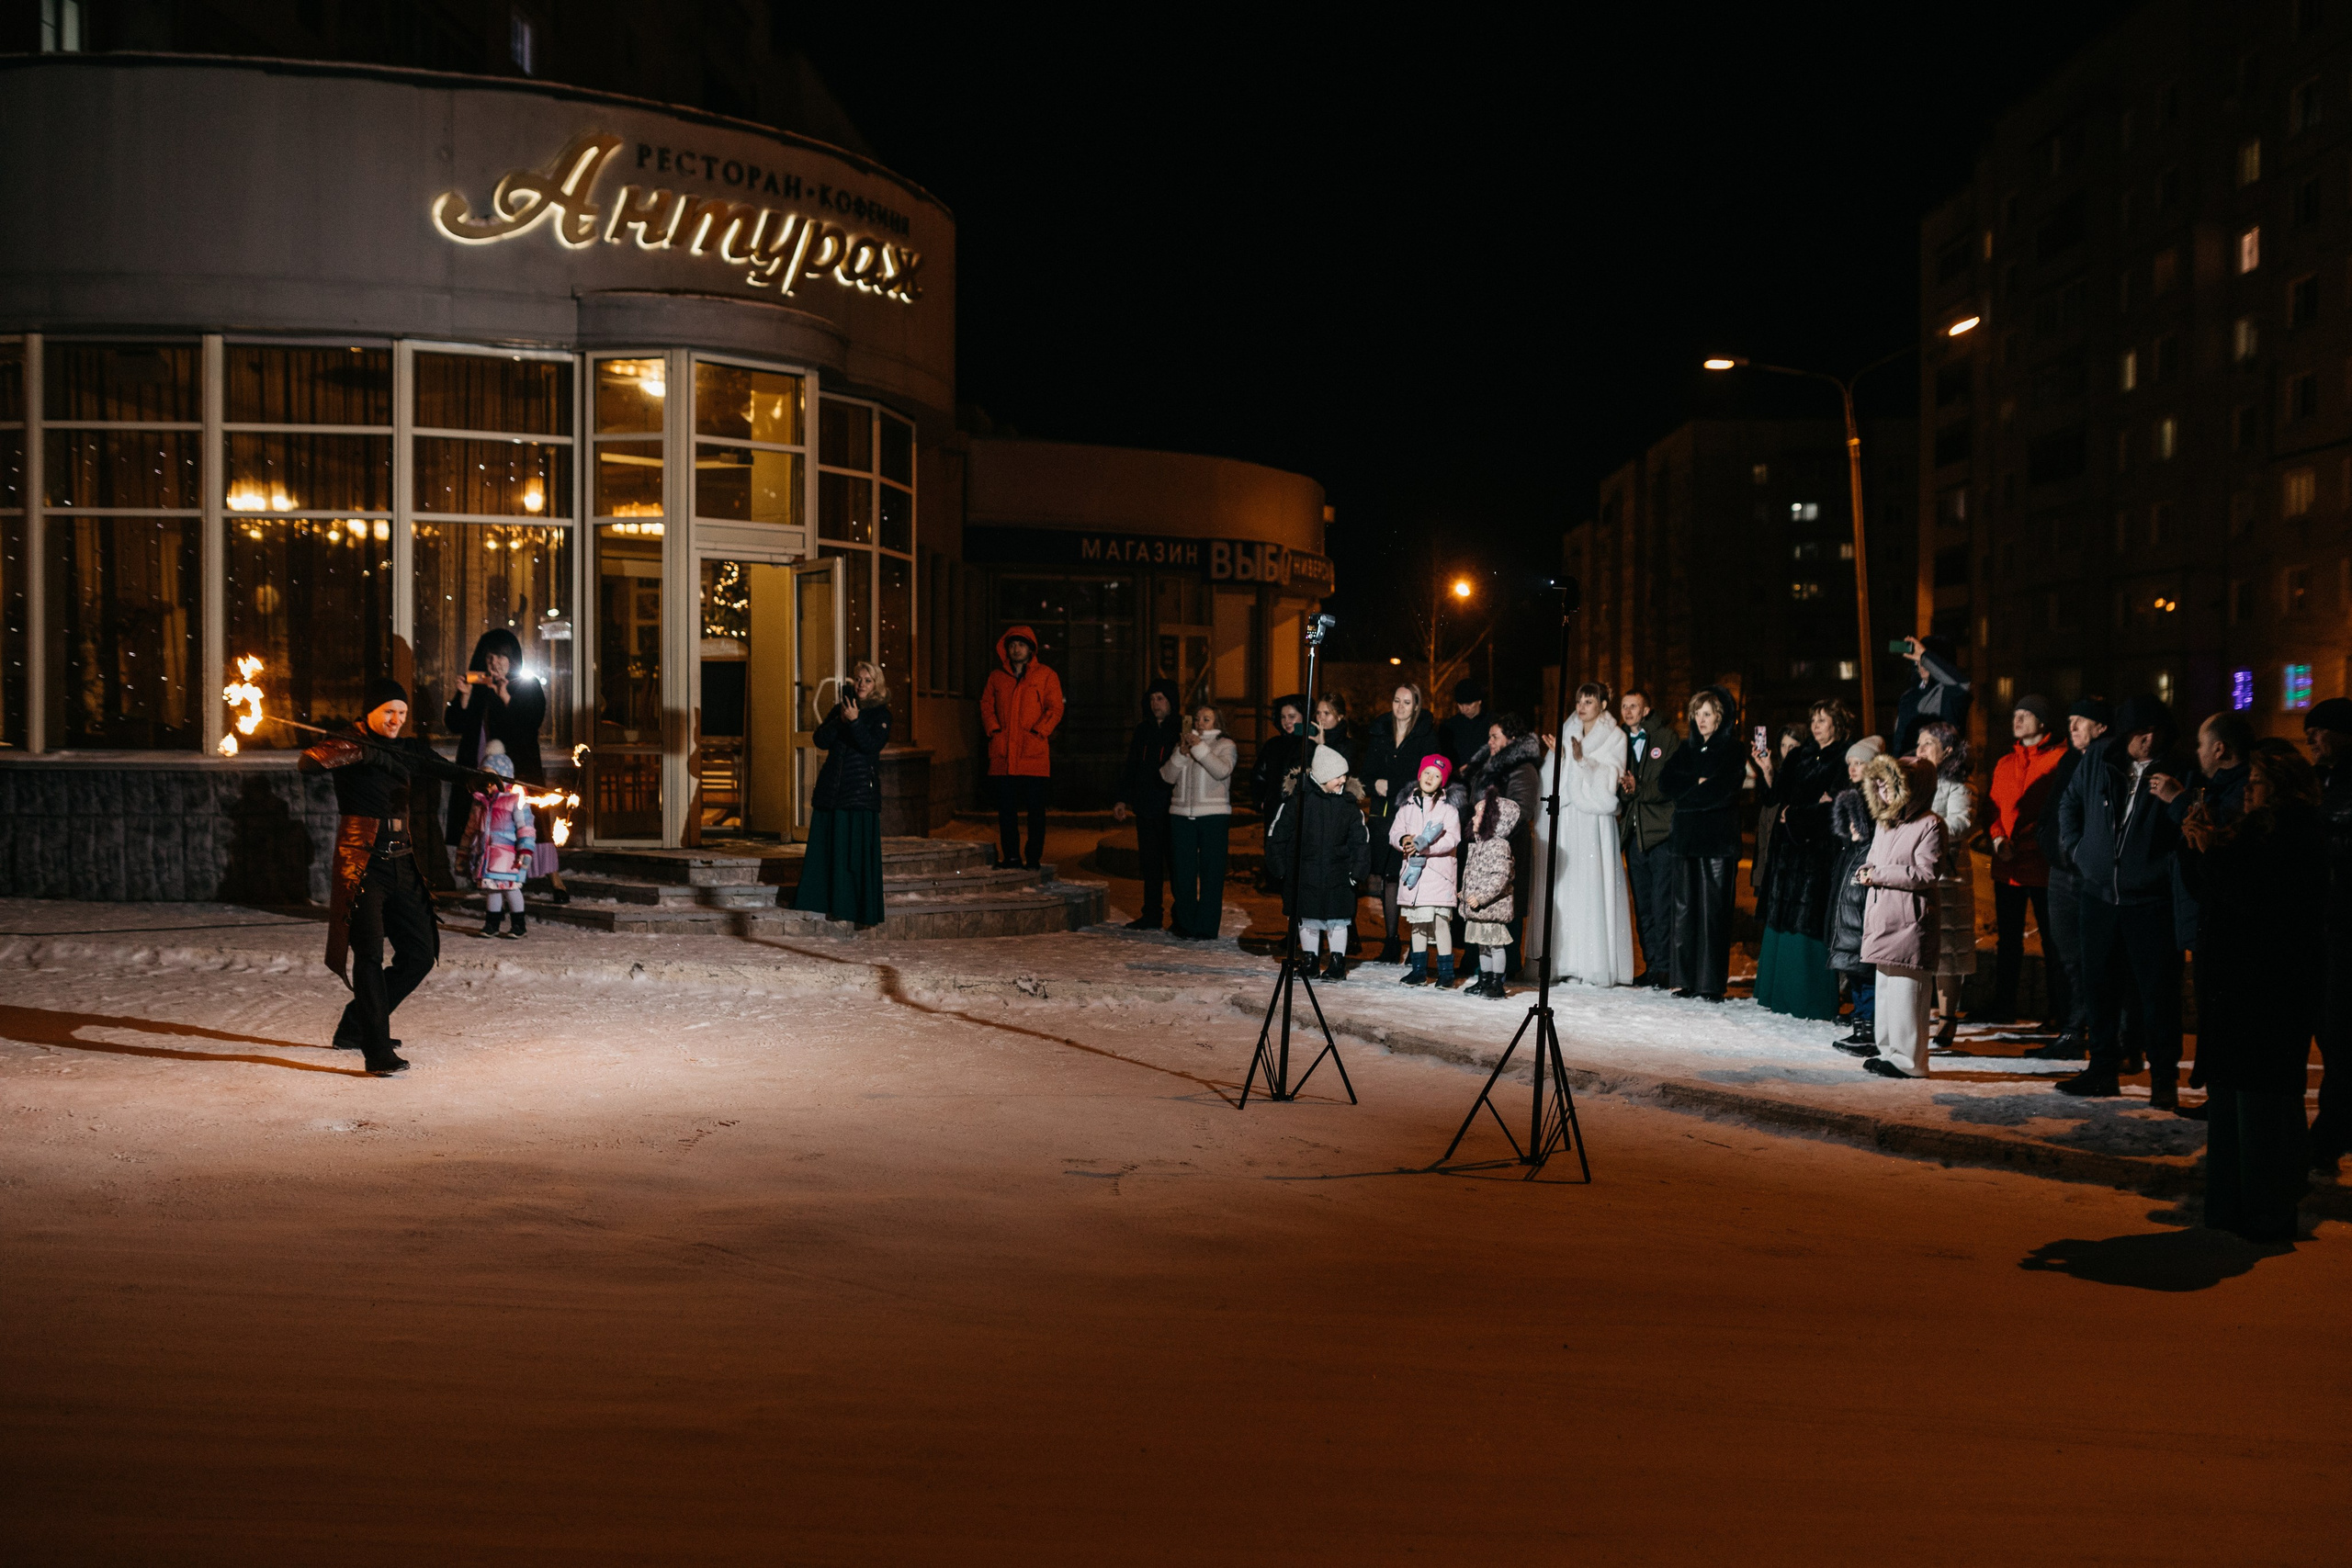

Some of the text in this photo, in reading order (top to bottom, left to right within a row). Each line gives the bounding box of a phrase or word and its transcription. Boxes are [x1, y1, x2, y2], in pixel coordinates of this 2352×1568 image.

[638, 143, 802, 200] РЕСТОРАН
[432, 133, 925, 306] Антураж
[1081, 538, 1198, 566] МАГАЗИН
